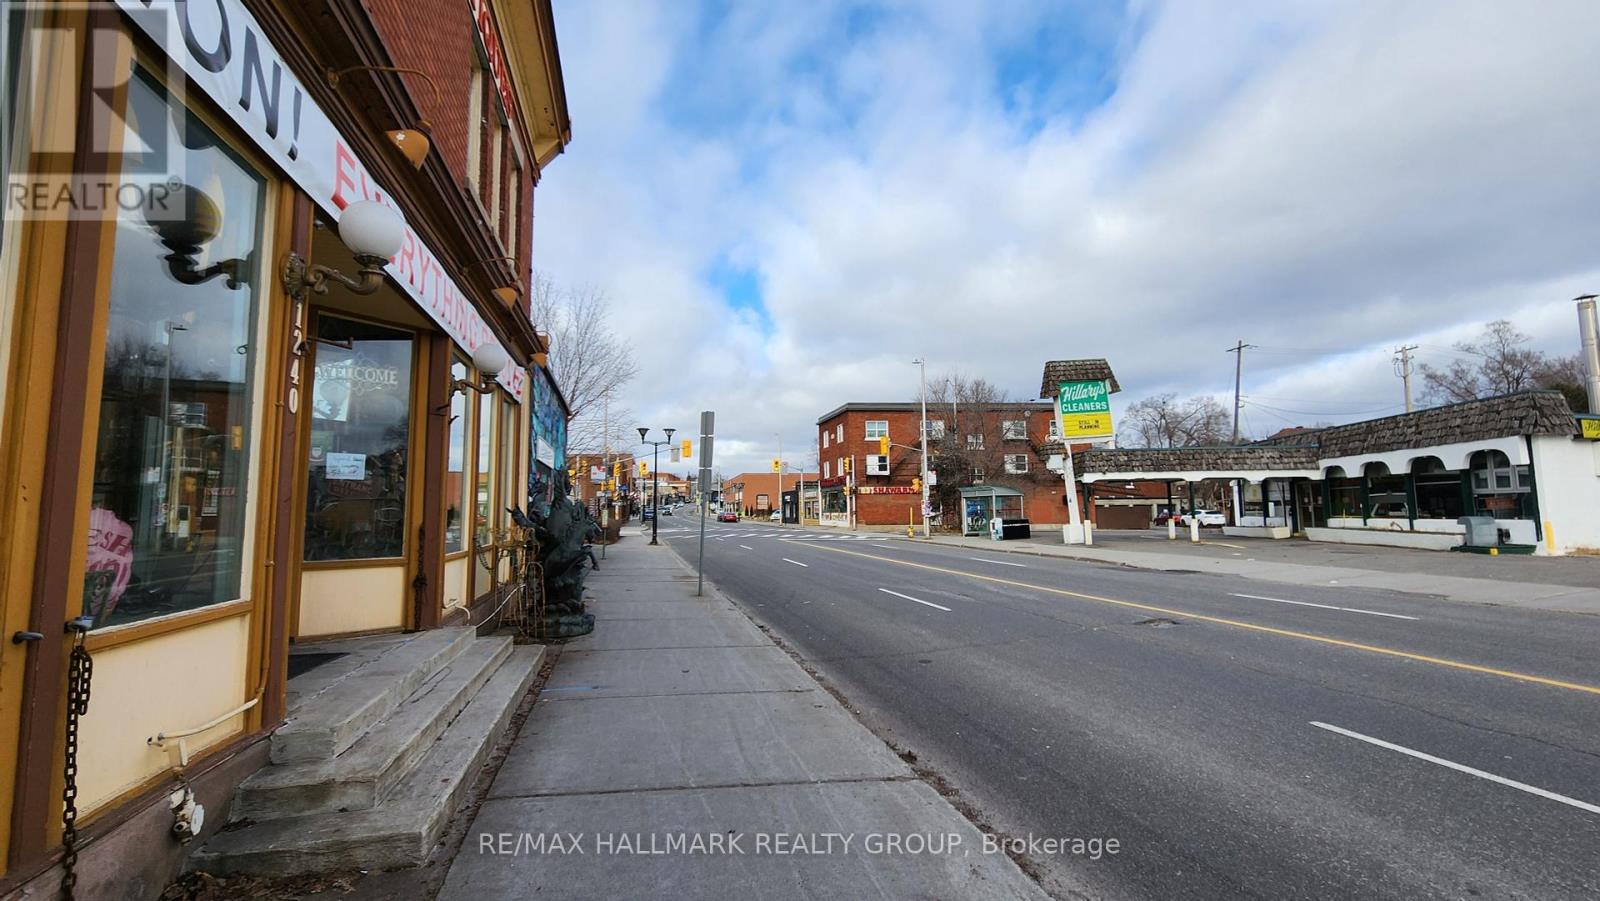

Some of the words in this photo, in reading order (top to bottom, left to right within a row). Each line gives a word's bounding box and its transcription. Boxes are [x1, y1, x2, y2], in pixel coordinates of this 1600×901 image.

[331, 139, 478, 353] ERYTHING
[289, 303, 303, 414] 1240
[317, 366, 398, 385] WELCOME
[1061, 381, 1105, 402] Hillary's
[1062, 401, 1107, 412] CLEANERS
